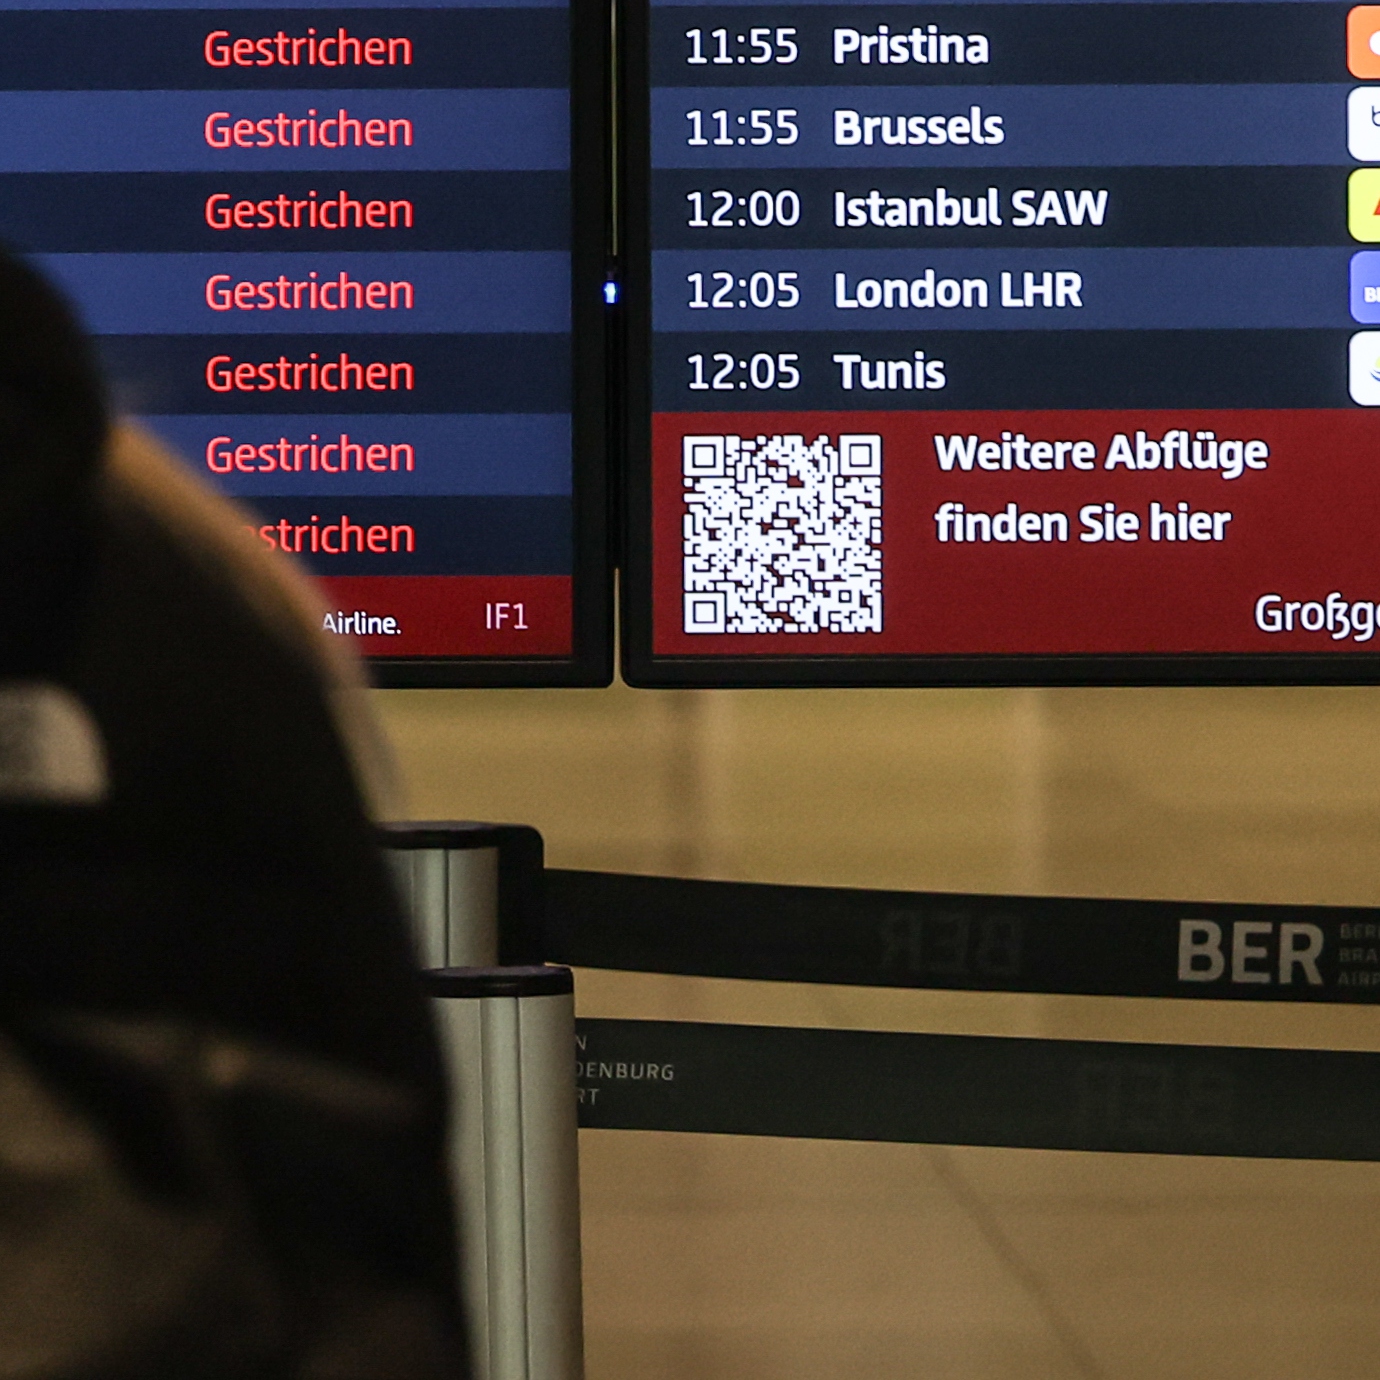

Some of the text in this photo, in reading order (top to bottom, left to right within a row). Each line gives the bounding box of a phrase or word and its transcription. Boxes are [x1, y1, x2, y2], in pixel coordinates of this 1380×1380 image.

[835, 25, 988, 63] Pristina
[687, 110, 798, 145] 11:55
[835, 107, 1004, 144] Brussels
[205, 191, 413, 230] Gestrichen
[836, 188, 1107, 227] Istanbul SAW
[836, 269, 1082, 307] London LHR
[689, 354, 799, 389] 12:05
[834, 351, 945, 389] Tunis
[935, 431, 1267, 479] Weitere Abflüge
[935, 503, 1231, 541] finden Sie hier
[323, 612, 400, 634] Airline.
[487, 603, 527, 629] IF1
[1178, 920, 1323, 984] BER
